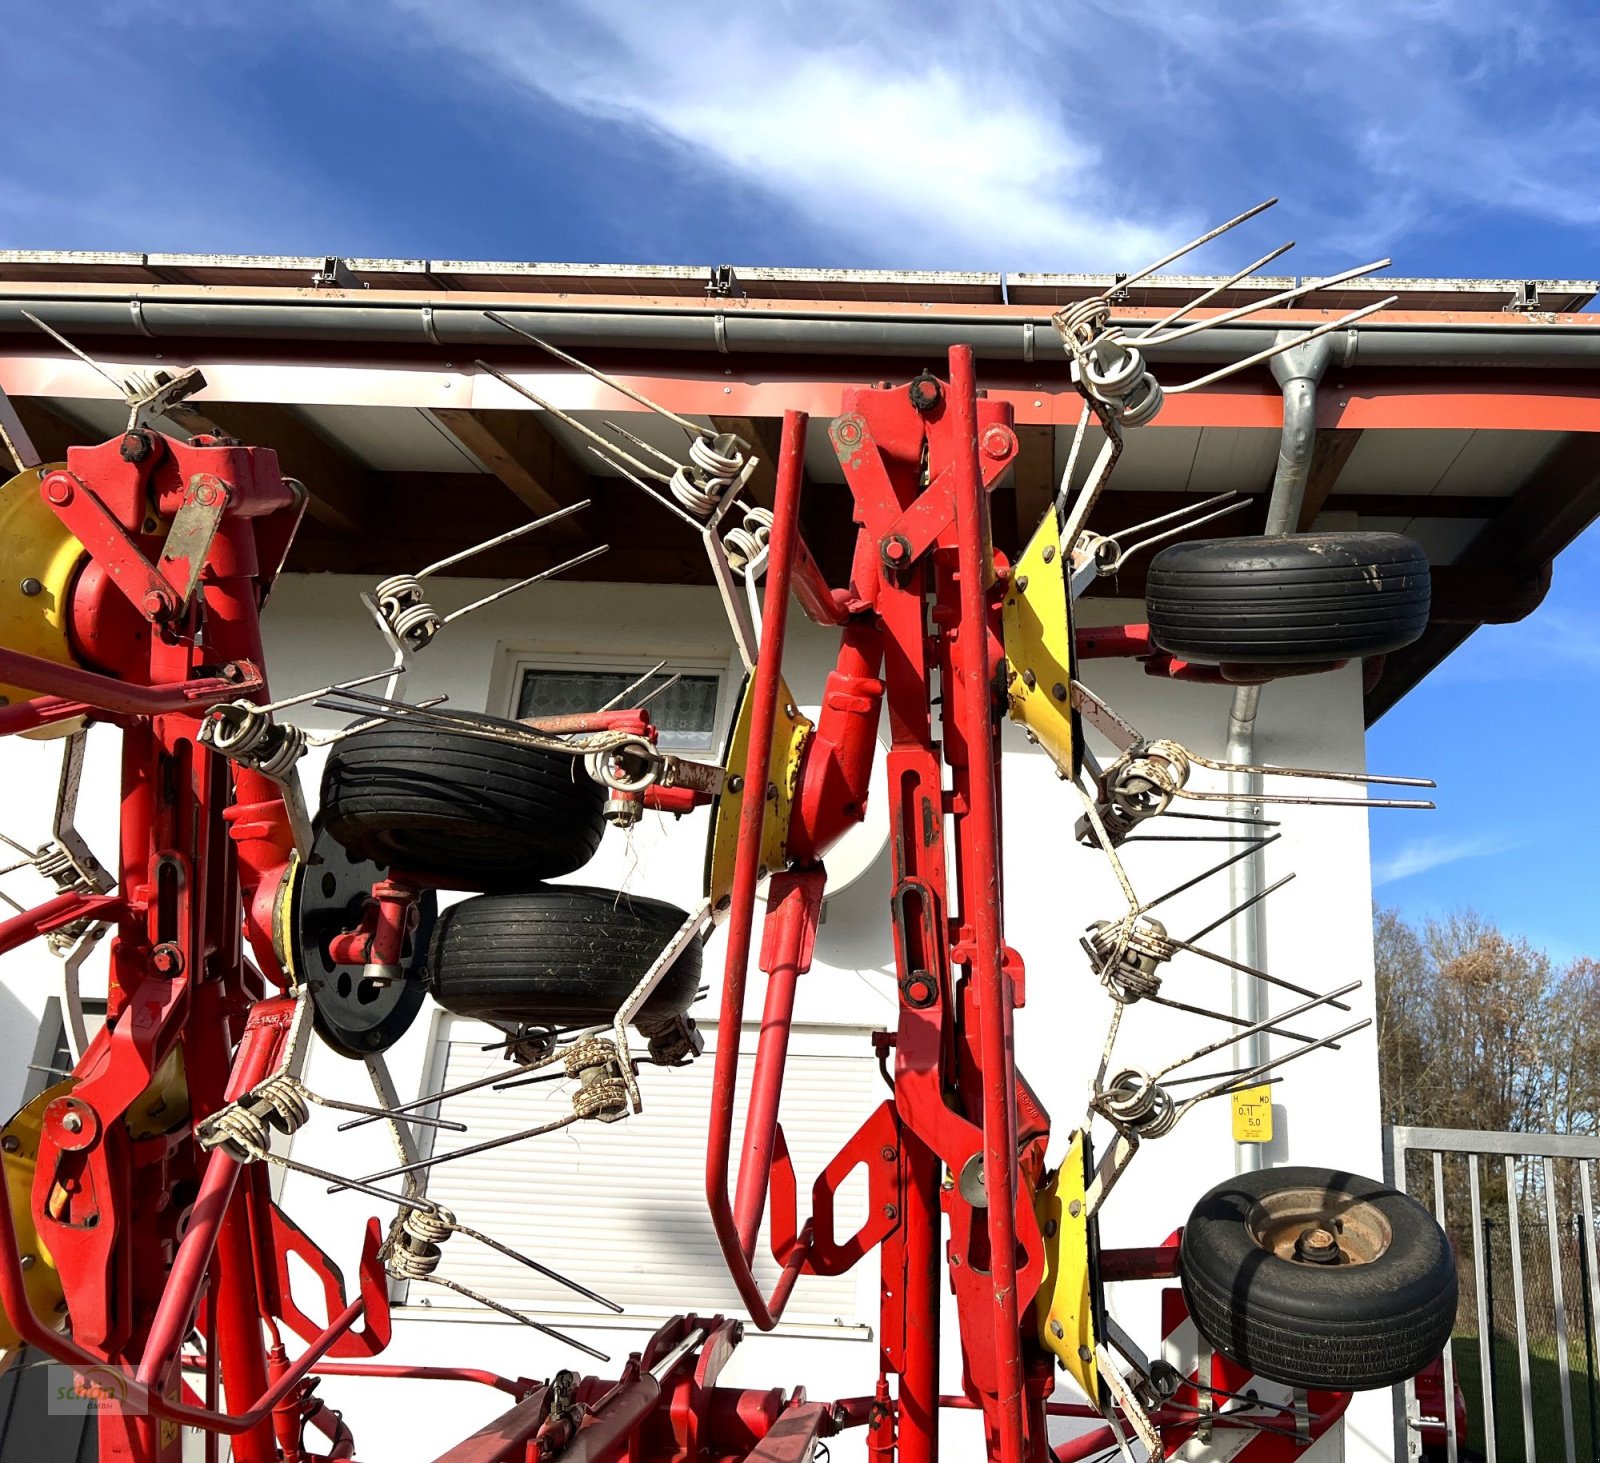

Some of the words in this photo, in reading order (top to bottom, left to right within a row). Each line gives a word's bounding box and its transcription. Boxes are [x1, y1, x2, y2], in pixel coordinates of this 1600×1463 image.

[1233, 1095, 1239, 1103] H
[1259, 1095, 1270, 1104] MD
[1248, 1118, 1261, 1127] 5.0
